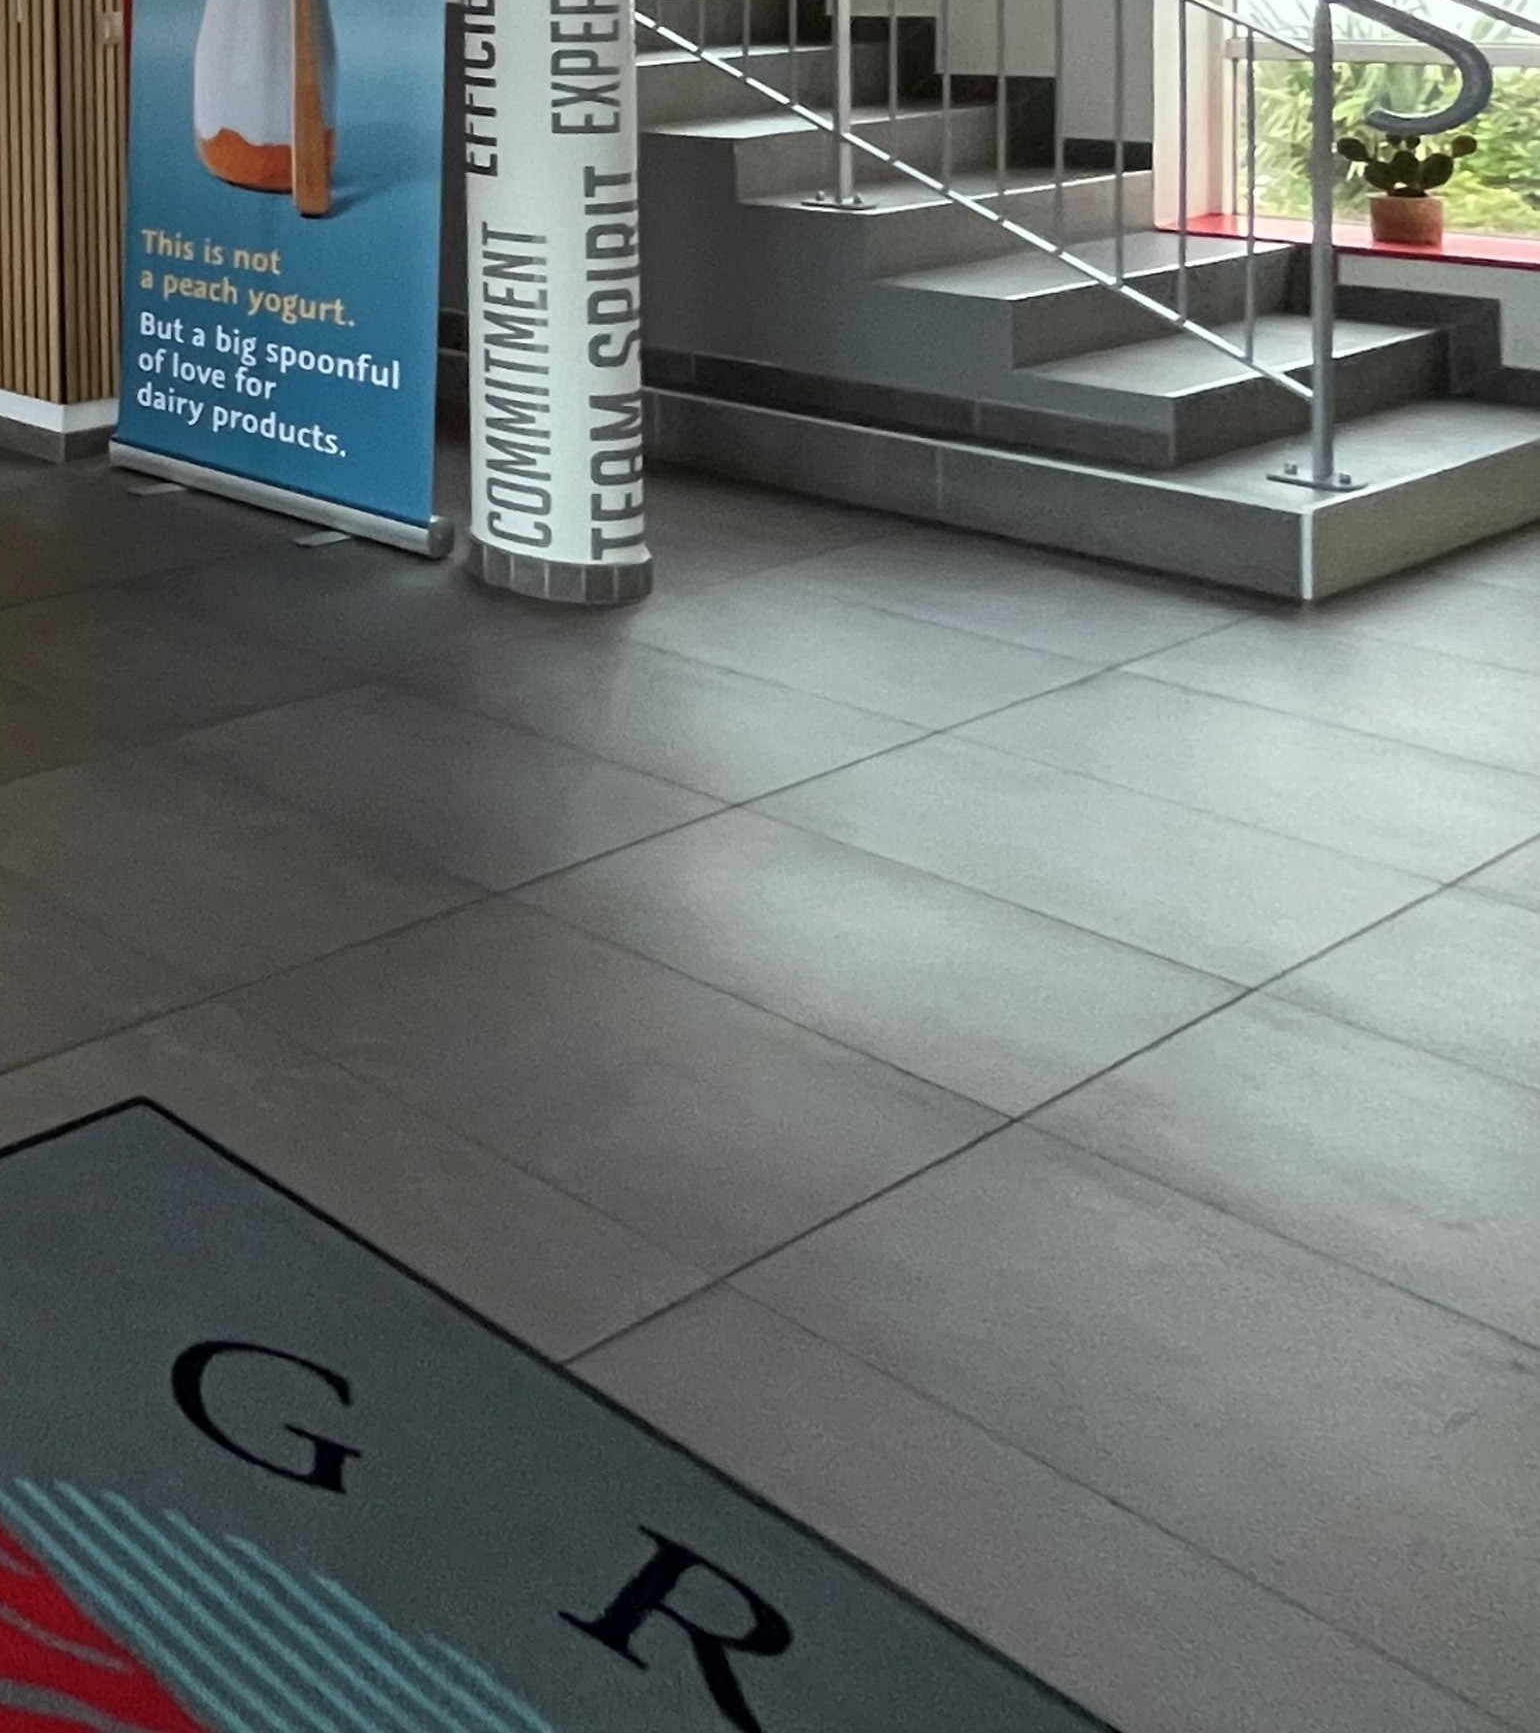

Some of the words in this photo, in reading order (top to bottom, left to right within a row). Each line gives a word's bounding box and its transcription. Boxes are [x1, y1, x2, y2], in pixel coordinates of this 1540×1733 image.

[141, 229, 195, 261] This
[204, 237, 224, 266] is
[233, 247, 282, 276] not
[583, 166, 642, 369] SPIRIT
[139, 269, 154, 289] a
[163, 274, 238, 305] peach
[247, 288, 355, 327] yogurt.
[137, 348, 167, 374] of
[172, 351, 226, 389] love
[234, 365, 277, 400] for
[139, 311, 184, 344] But
[191, 326, 206, 347] a
[216, 324, 257, 367] big
[266, 341, 400, 390] spoonful
[482, 220, 552, 549] COMMITMENT
[136, 381, 204, 426] dairy
[212, 404, 347, 458] products.
[590, 393, 645, 561] TEAM
